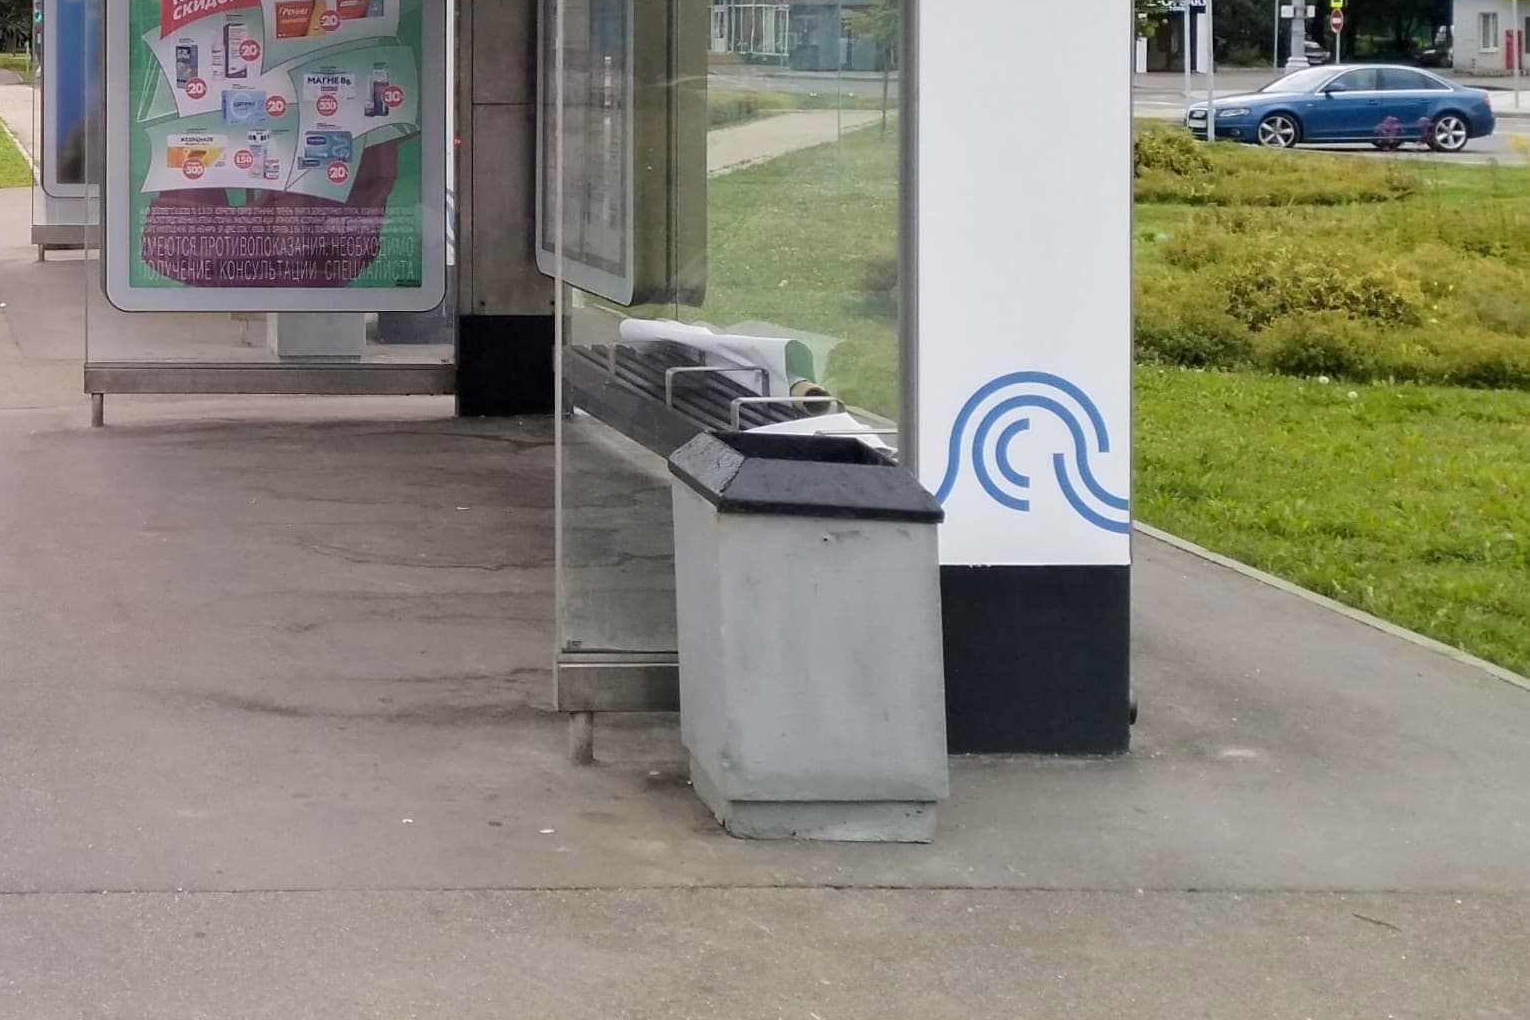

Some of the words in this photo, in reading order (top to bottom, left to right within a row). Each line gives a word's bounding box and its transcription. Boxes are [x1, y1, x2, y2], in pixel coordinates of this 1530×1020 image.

[142, 236, 197, 257] ИМЕЮТСЯ
[331, 236, 415, 257] НЕОБХОДИМО
[142, 260, 212, 280] ПОЛУЧЕНИЕ
[220, 260, 317, 283] КОНСУЛЬТАЦИИ
[324, 260, 415, 282] СПЕЦИАЛИСТА
